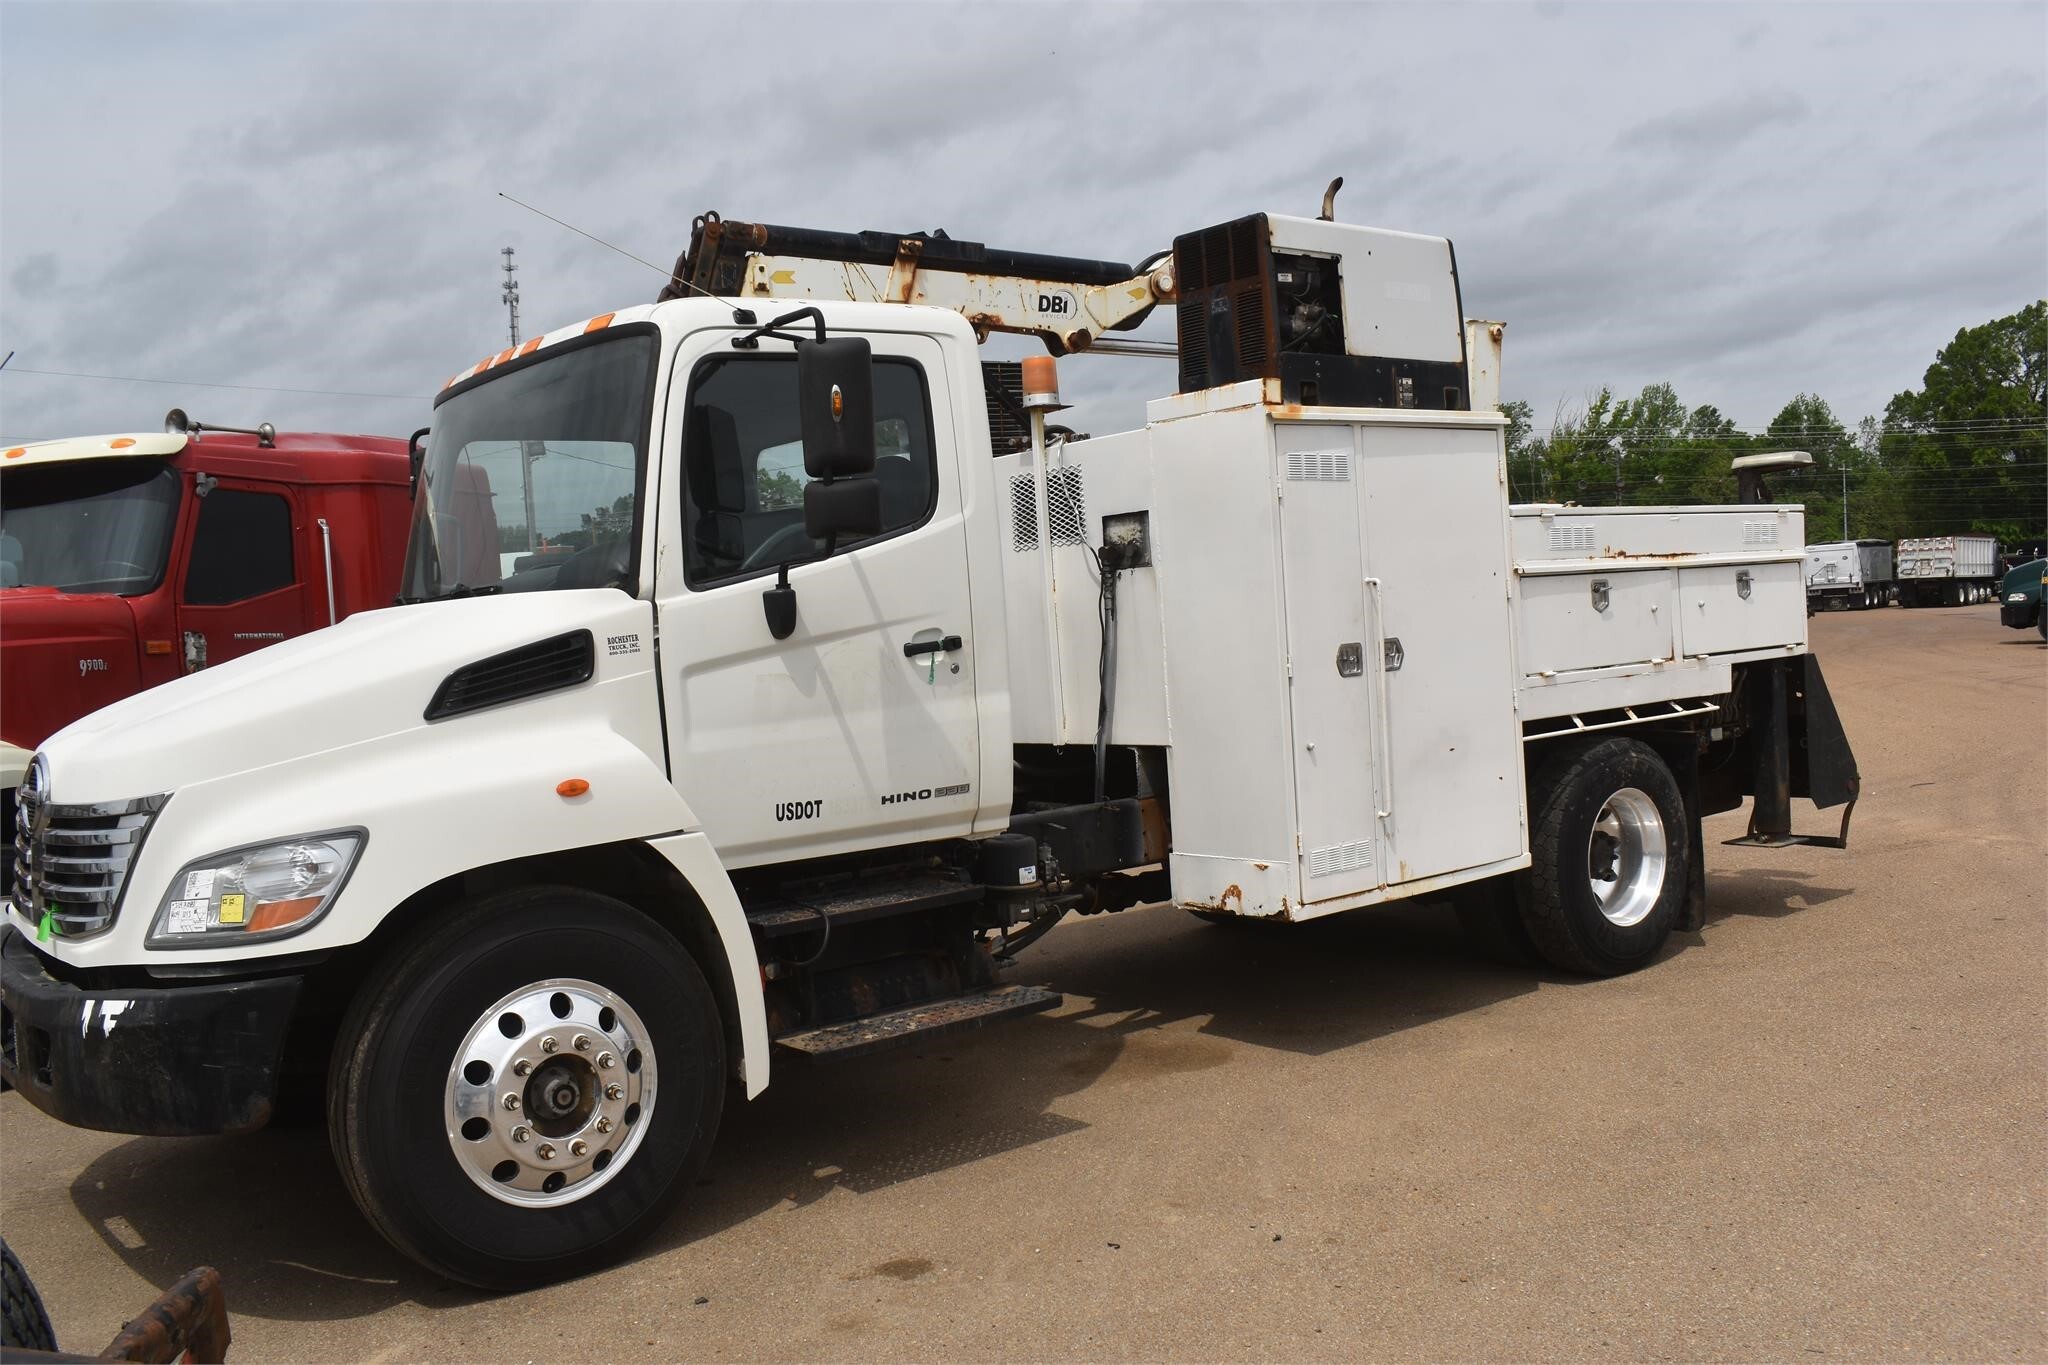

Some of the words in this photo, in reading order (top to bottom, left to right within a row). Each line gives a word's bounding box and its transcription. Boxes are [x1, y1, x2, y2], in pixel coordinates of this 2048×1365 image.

[234, 632, 285, 640] INTERNATIONAL
[607, 634, 639, 644] ROCHESTER
[79, 659, 108, 677] 9900i
[881, 789, 932, 805] HINO
[776, 800, 823, 822] USDOT
